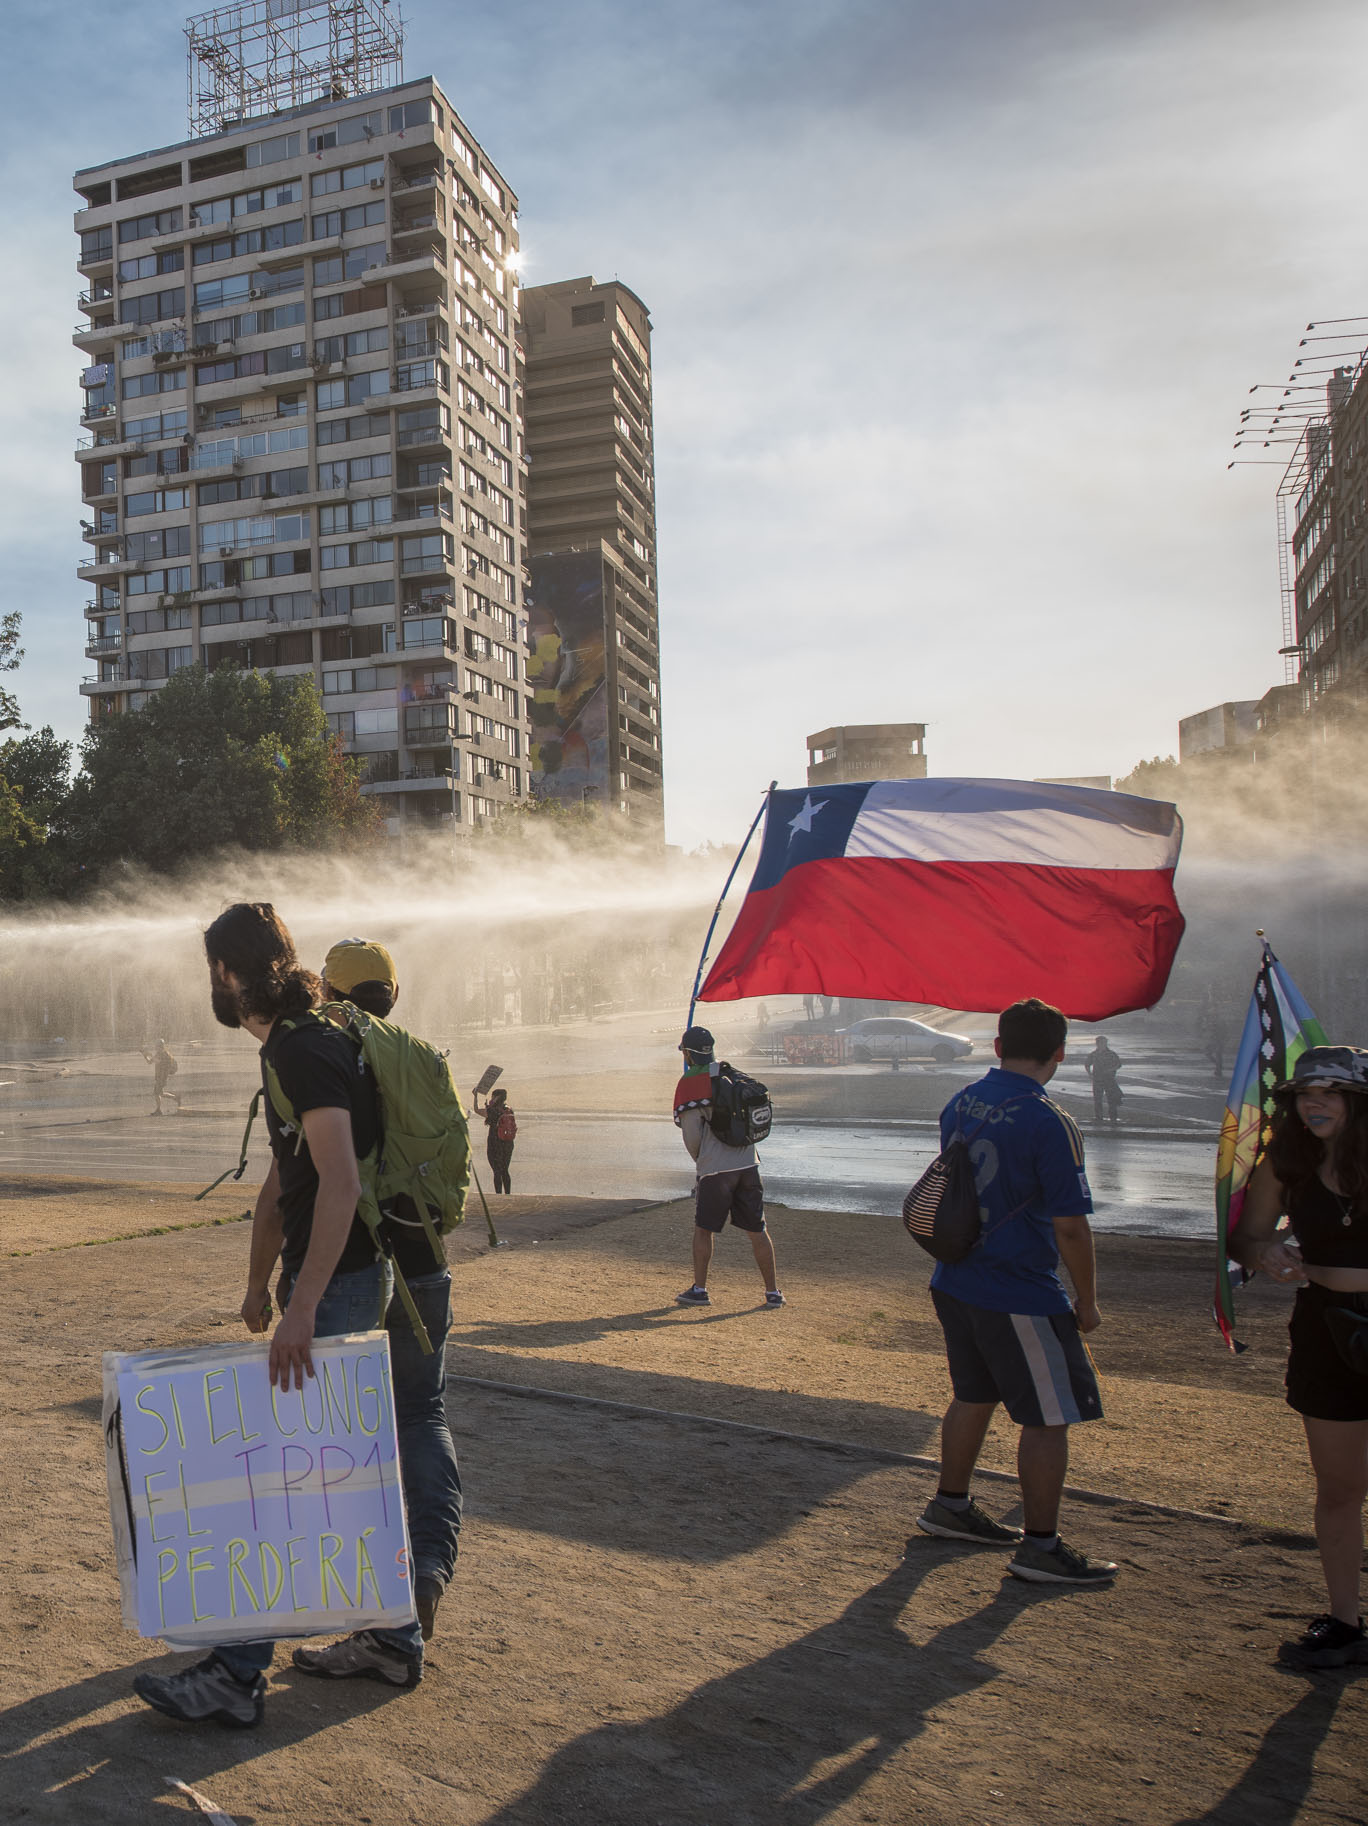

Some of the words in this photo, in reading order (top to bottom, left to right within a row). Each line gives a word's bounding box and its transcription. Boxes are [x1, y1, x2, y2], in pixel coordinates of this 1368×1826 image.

[136, 1382, 187, 1456] SI
[203, 1367, 262, 1445] EL
[144, 1459, 212, 1544] EL
[157, 1526, 384, 1629] PERDERÁ
